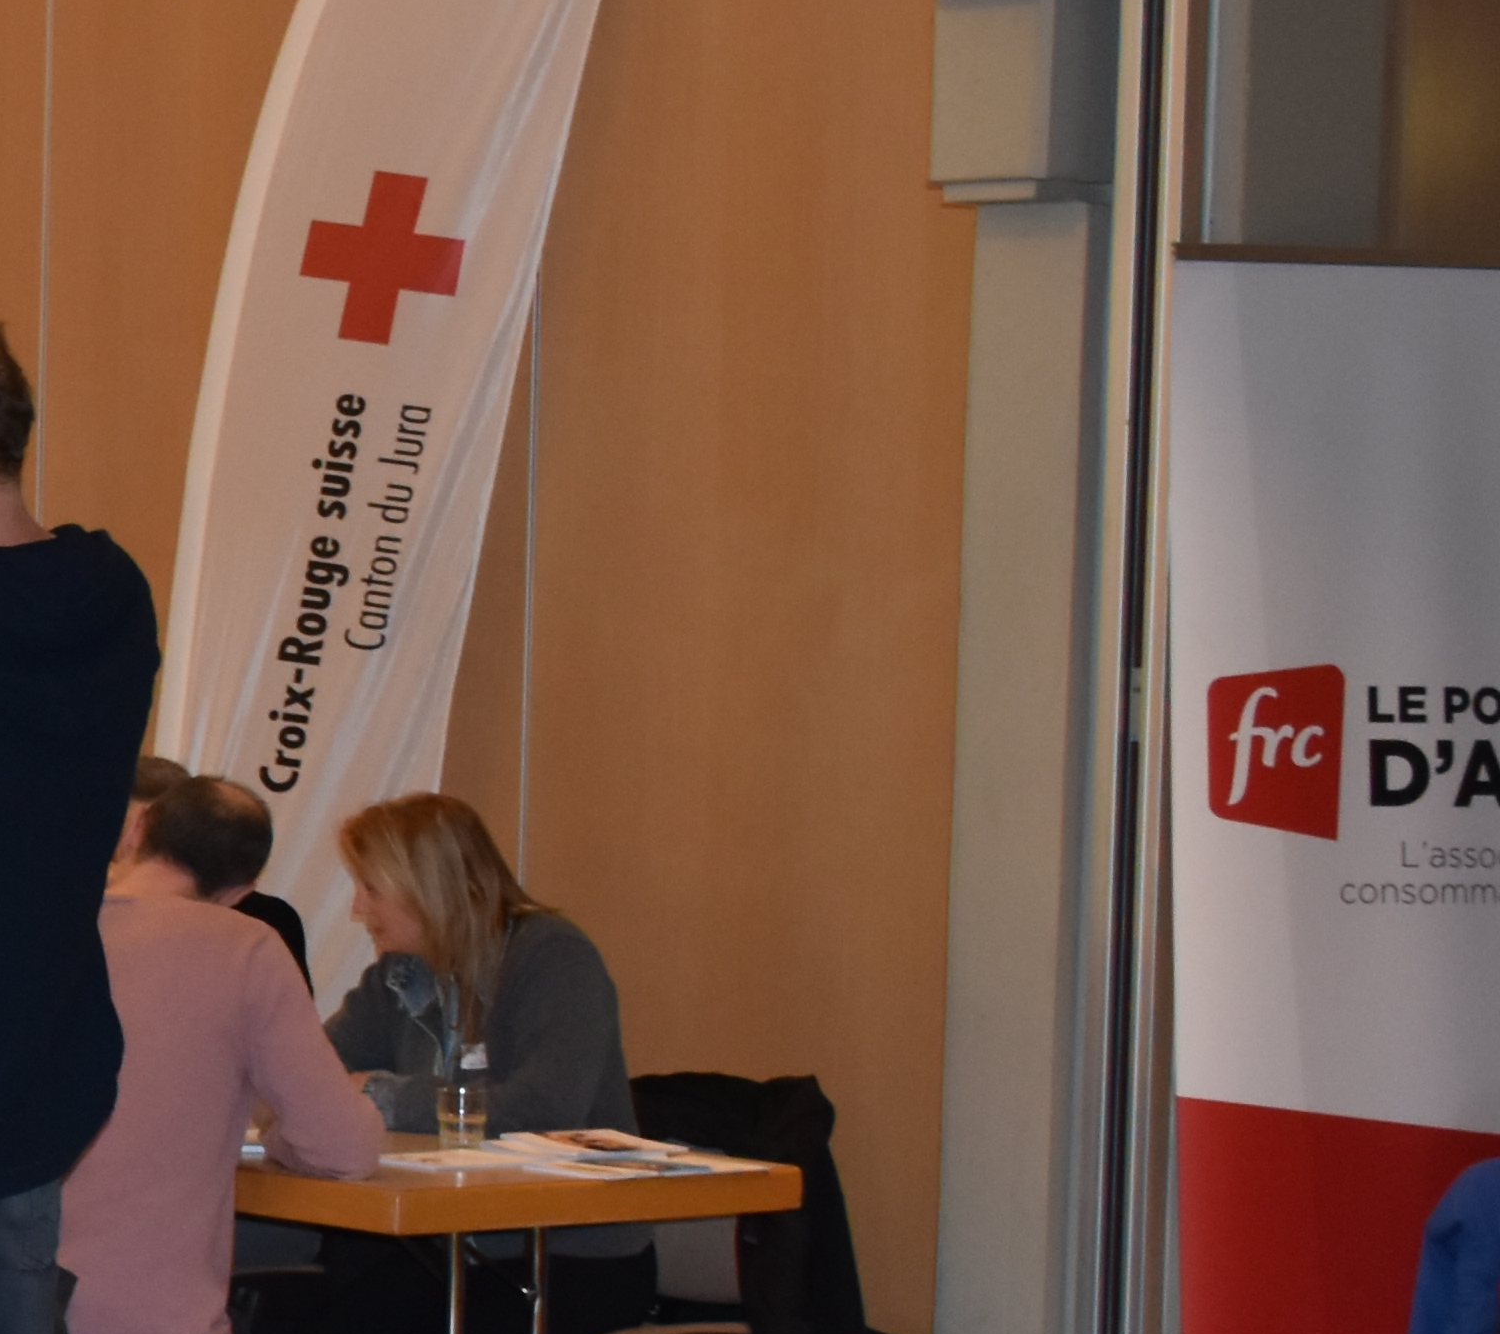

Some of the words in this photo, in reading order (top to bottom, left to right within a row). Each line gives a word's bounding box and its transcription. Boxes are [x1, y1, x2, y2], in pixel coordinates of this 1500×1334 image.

[377, 403, 432, 475] Jura
[366, 482, 415, 525] du
[258, 534, 350, 794] Croix-Rouge
[311, 393, 367, 521] suisse
[344, 534, 403, 652] Canton
[1367, 685, 1429, 724] LE
[1227, 685, 1325, 807] frc
[1401, 840, 1500, 869] L'asso
[1339, 881, 1500, 905] consomm
